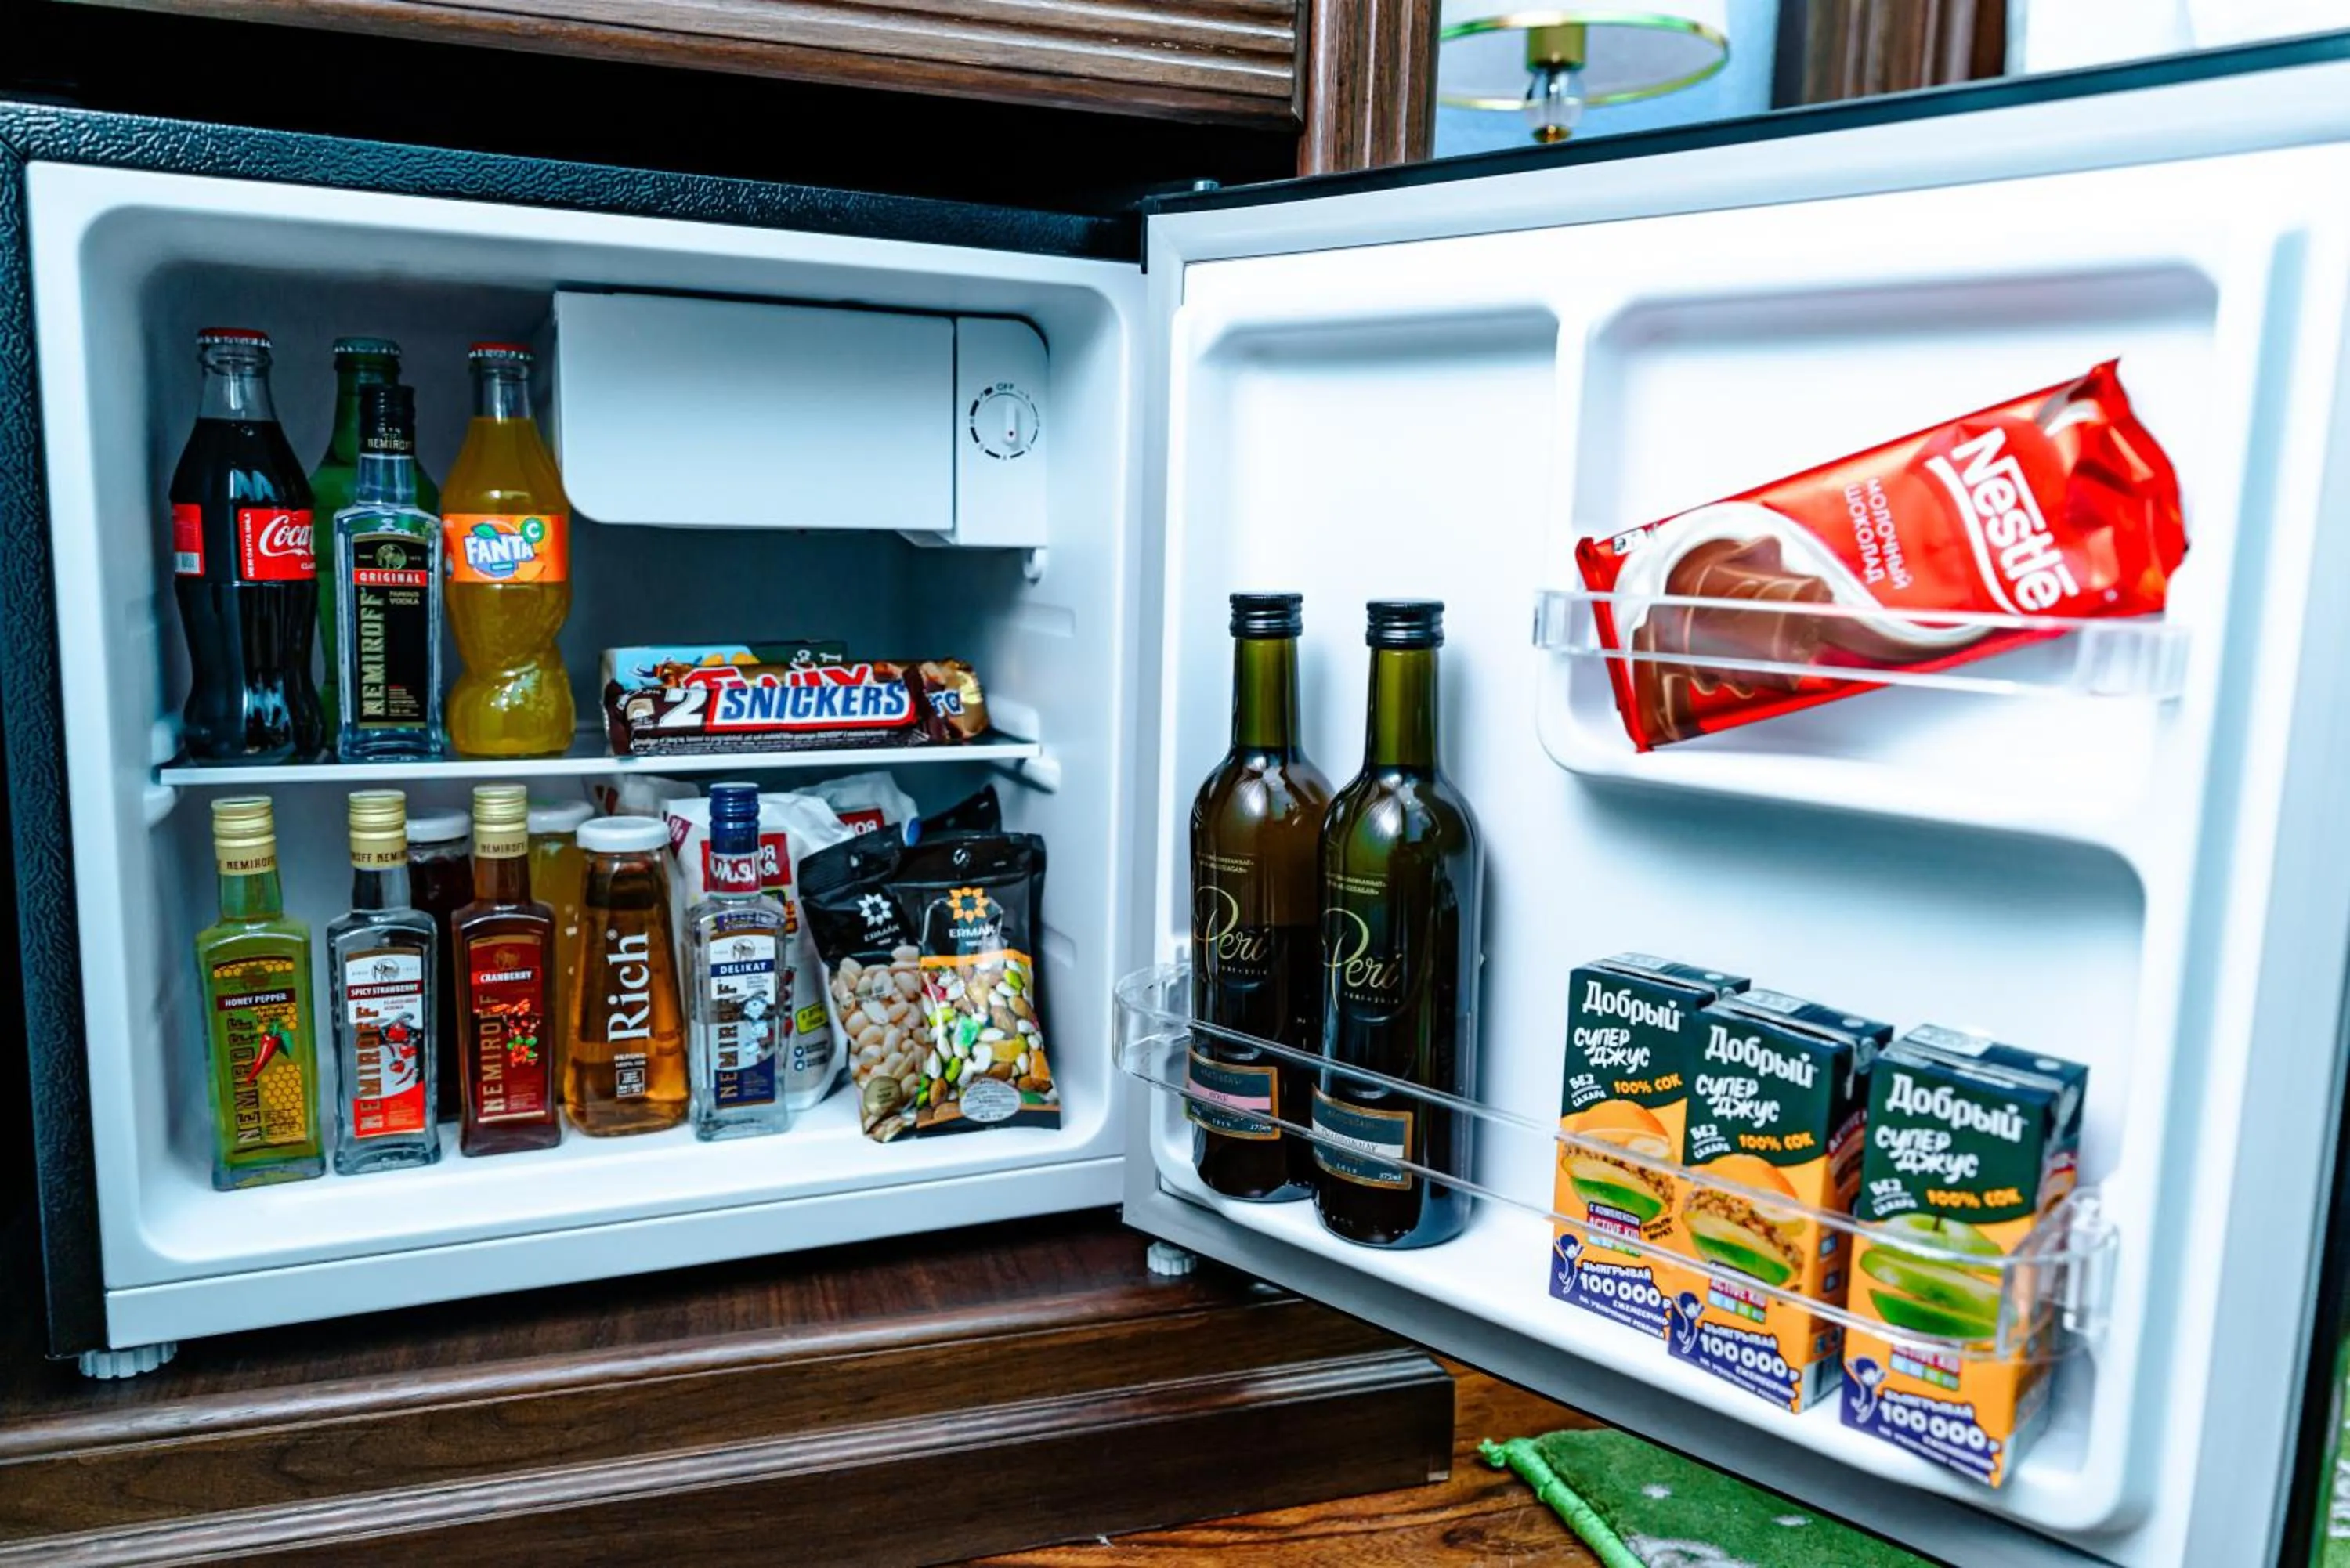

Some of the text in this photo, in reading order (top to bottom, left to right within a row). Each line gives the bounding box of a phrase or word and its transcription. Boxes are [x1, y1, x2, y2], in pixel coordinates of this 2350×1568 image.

[996, 382, 1014, 391] OFF
[1950, 425, 2079, 610] Nestlé
[1844, 482, 1885, 586] ШОКОЛАД
[1867, 477, 1912, 590] МОЛОЧНЫЙ
[465, 535, 534, 565] FANTA
[360, 571, 421, 583] ORIGINAL
[360, 593, 385, 716] NEMIROFF
[720, 681, 907, 720] SNICKERS
[480, 970, 532, 984] CRANBERRY
[720, 962, 766, 975] DELIKAT
[225, 992, 287, 1007] HONEY PEPPER
[350, 983, 419, 997] SPICY STRAWBERRY
[607, 931, 650, 1043] Rich
[1582, 980, 1680, 1032] Добрый
[479, 995, 505, 1113] NEMIROFF
[1574, 1026, 1630, 1056] СУПЕР
[1705, 1024, 1813, 1089] Добрый
[356, 1006, 383, 1130] NEMIROFF
[1589, 1047, 1650, 1075] ДЖУС
[227, 1017, 261, 1143] NEMIROFF
[1569, 1073, 1596, 1090] БЕЗ
[1614, 1079, 1653, 1094] 100%
[1654, 1072, 1683, 1091] СОК
[1695, 1074, 1759, 1105] СУПЕР
[1712, 1097, 1780, 1129] ДЖУС
[1885, 1072, 2023, 1143] Добрый
[1690, 1123, 1718, 1140] БЕЗ
[1738, 1131, 1815, 1151] 100% СОК
[1874, 1125, 1951, 1159] СУПЕР
[1894, 1151, 1979, 1184] ДЖУС
[1925, 1188, 1981, 1209] 100%
[1582, 1260, 1652, 1281] ВЫИГРЫВАЙ
